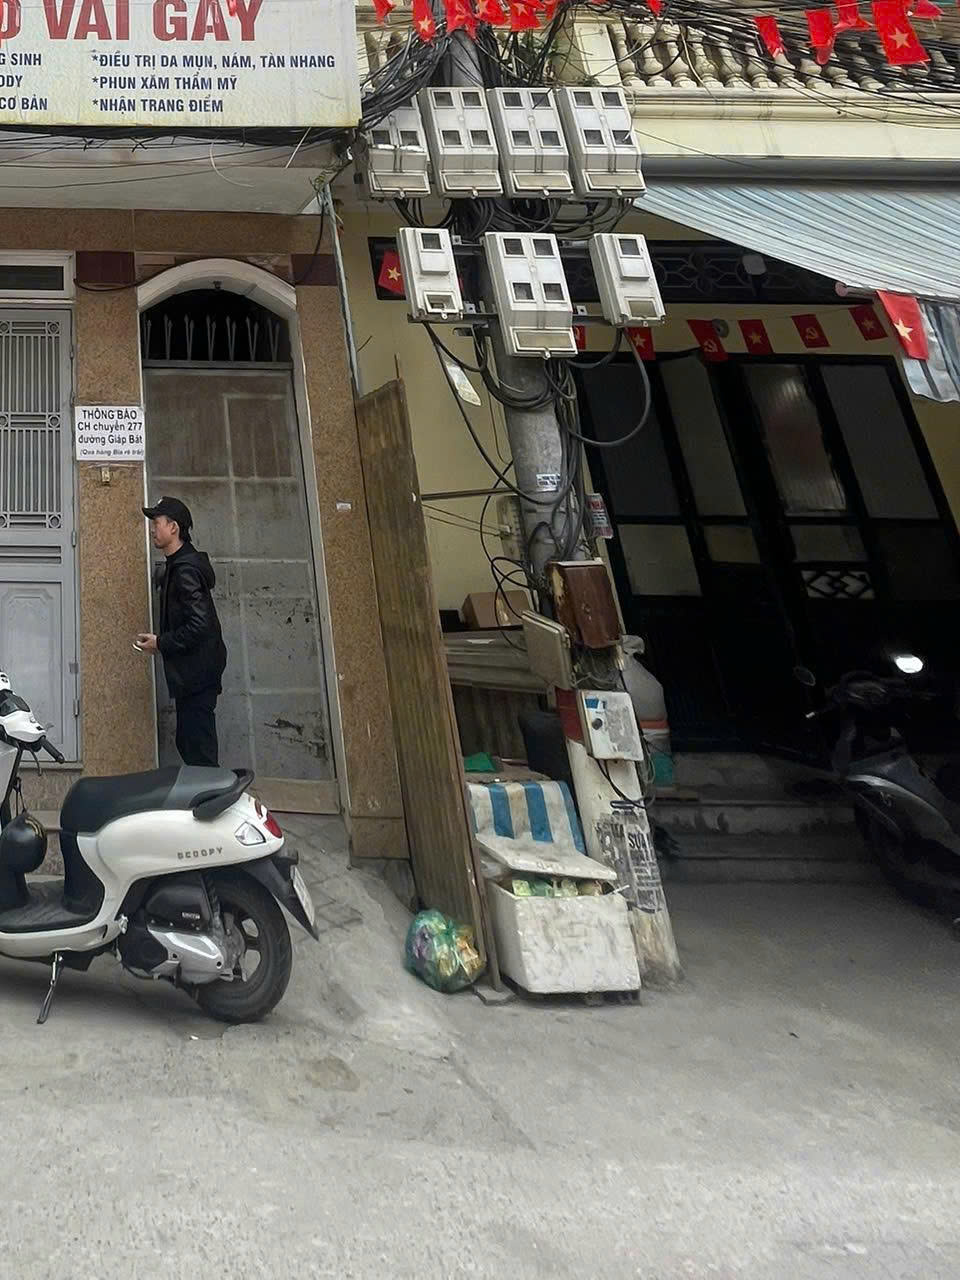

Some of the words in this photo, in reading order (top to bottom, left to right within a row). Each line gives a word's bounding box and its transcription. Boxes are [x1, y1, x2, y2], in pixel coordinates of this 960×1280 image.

[11, 53, 42, 65] SINH
[135, 55, 155, 70] TRỊ
[161, 55, 178, 67] DA
[183, 55, 217, 70] MỤN,
[222, 52, 256, 70] NÁM,
[260, 52, 285, 68] TÀN
[290, 55, 335, 68] NHANG
[217, 74, 237, 90] MỸ
[21, 94, 48, 110] BẢN
[141, 99, 184, 112] TRANG
[189, 94, 223, 112] ĐIỂM
[83, 408, 114, 419] THÔNG
[117, 408, 137, 419] BÁO
[78, 422, 90, 430] CH
[128, 422, 142, 431] 277
[177, 847, 223, 860] SCOOPY
